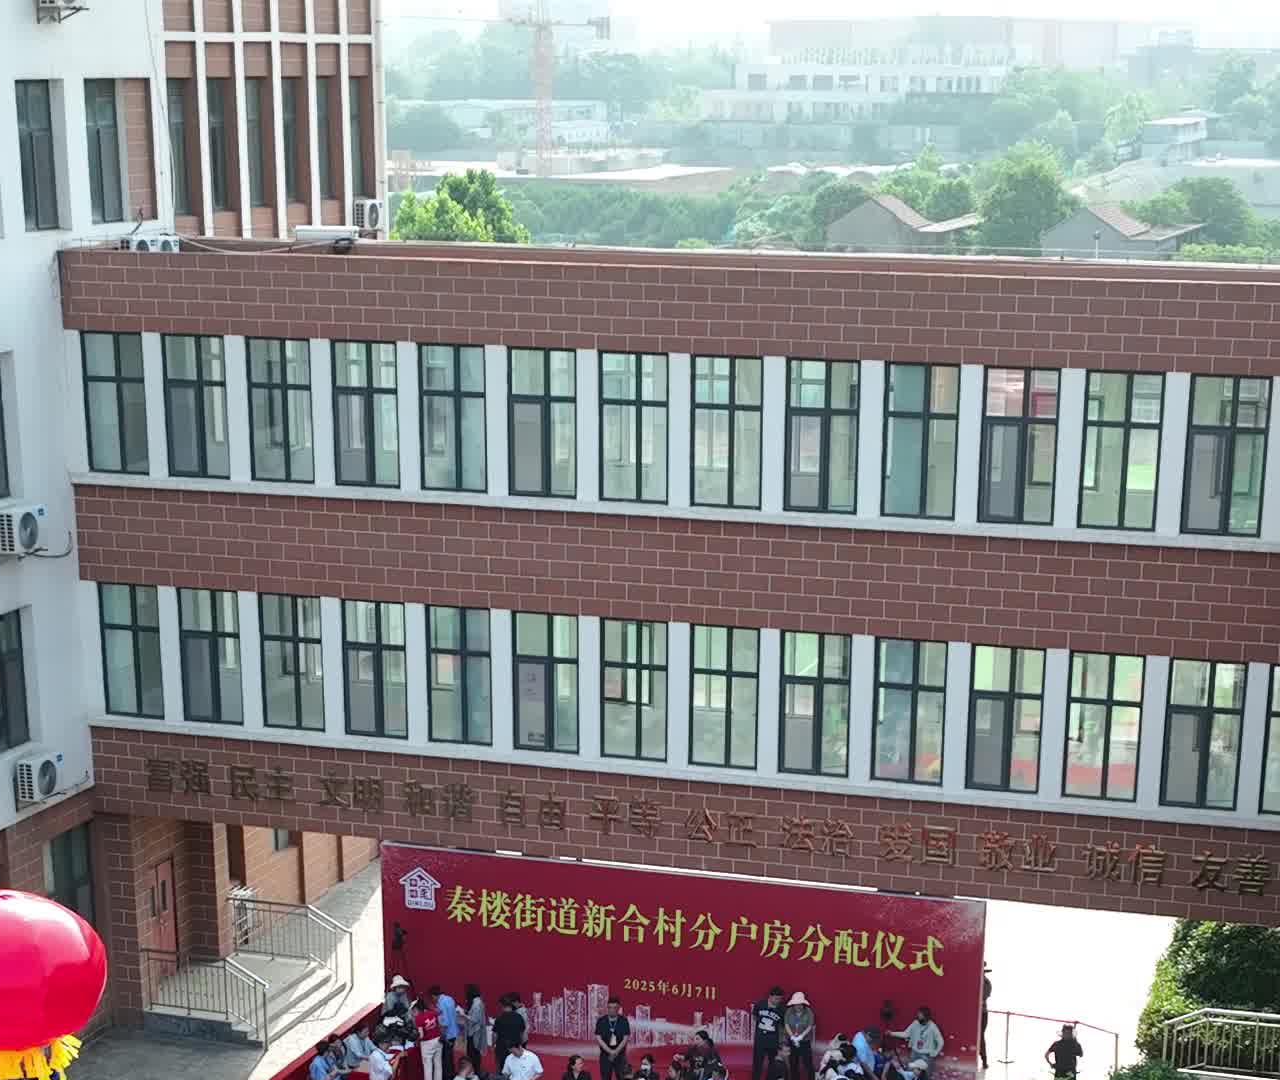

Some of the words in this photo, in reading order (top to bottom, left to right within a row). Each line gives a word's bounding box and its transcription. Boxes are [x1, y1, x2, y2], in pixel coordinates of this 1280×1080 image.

[229, 765, 294, 801] 民主
[500, 787, 567, 831] 自由
[589, 794, 663, 839] 平等
[685, 807, 757, 848] 公正
[780, 815, 855, 857] 法治
[879, 822, 958, 866] 爱国
[981, 830, 1058, 873] 敬业
[1082, 840, 1166, 888] 诚信
[1191, 849, 1269, 896] 友善
[446, 884, 945, 978] 秦楼街道新合村分户房分配仪式
[623, 978, 717, 1001] 2025年6月7日
